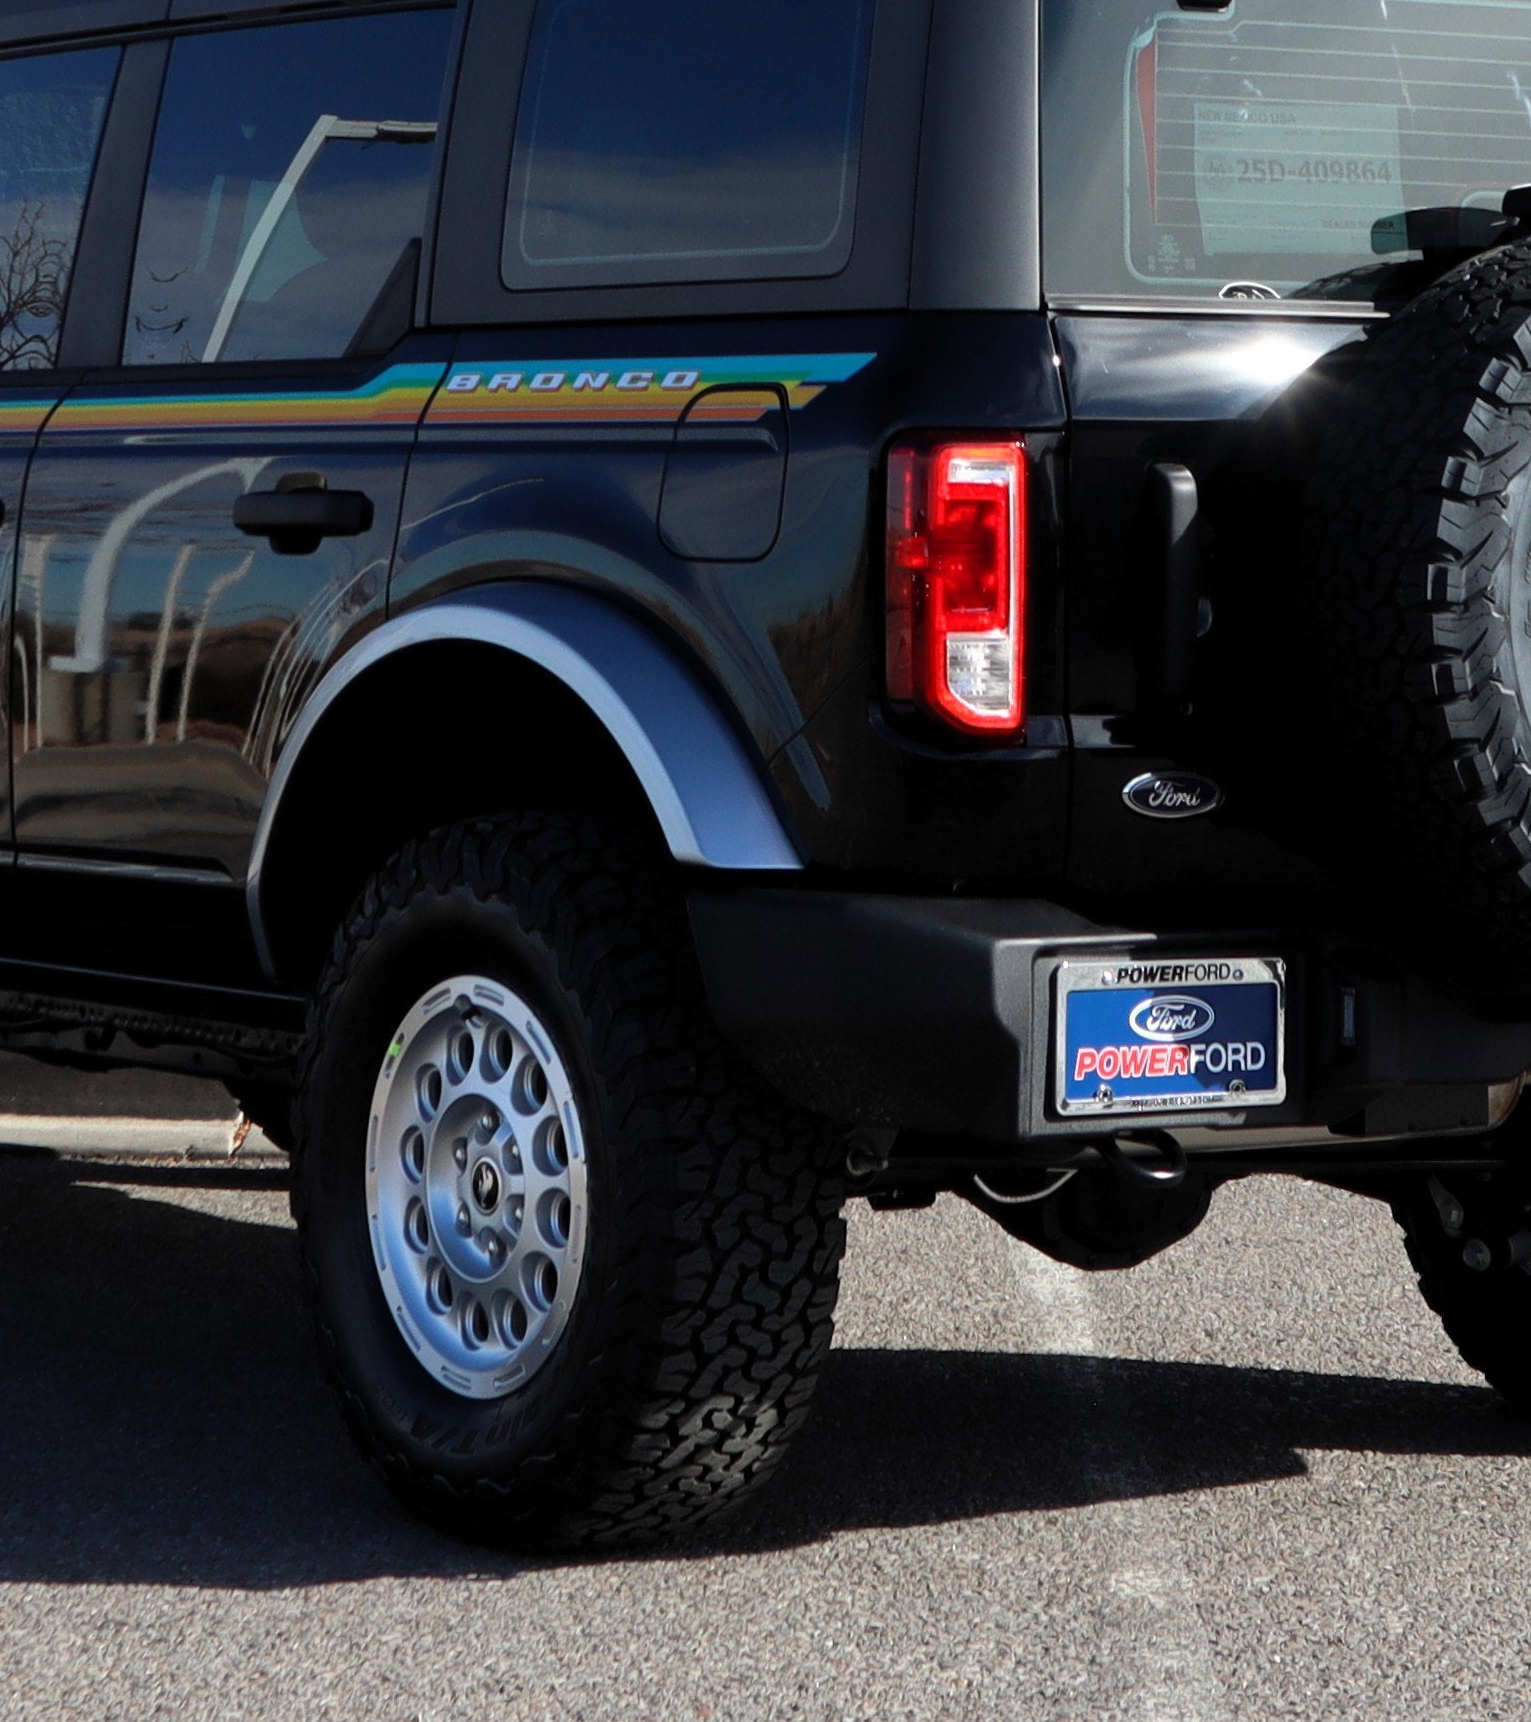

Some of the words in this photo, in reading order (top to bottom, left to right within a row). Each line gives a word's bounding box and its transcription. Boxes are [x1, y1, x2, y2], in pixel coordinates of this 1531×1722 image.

[1236, 159, 1392, 185] 25D-409864
[446, 369, 702, 394] BRONCO
[1148, 780, 1201, 808] Ford
[1116, 963, 1232, 983] POWERFORD
[1145, 1004, 1197, 1031] Ford
[1074, 1040, 1266, 1081] POWERFORD
